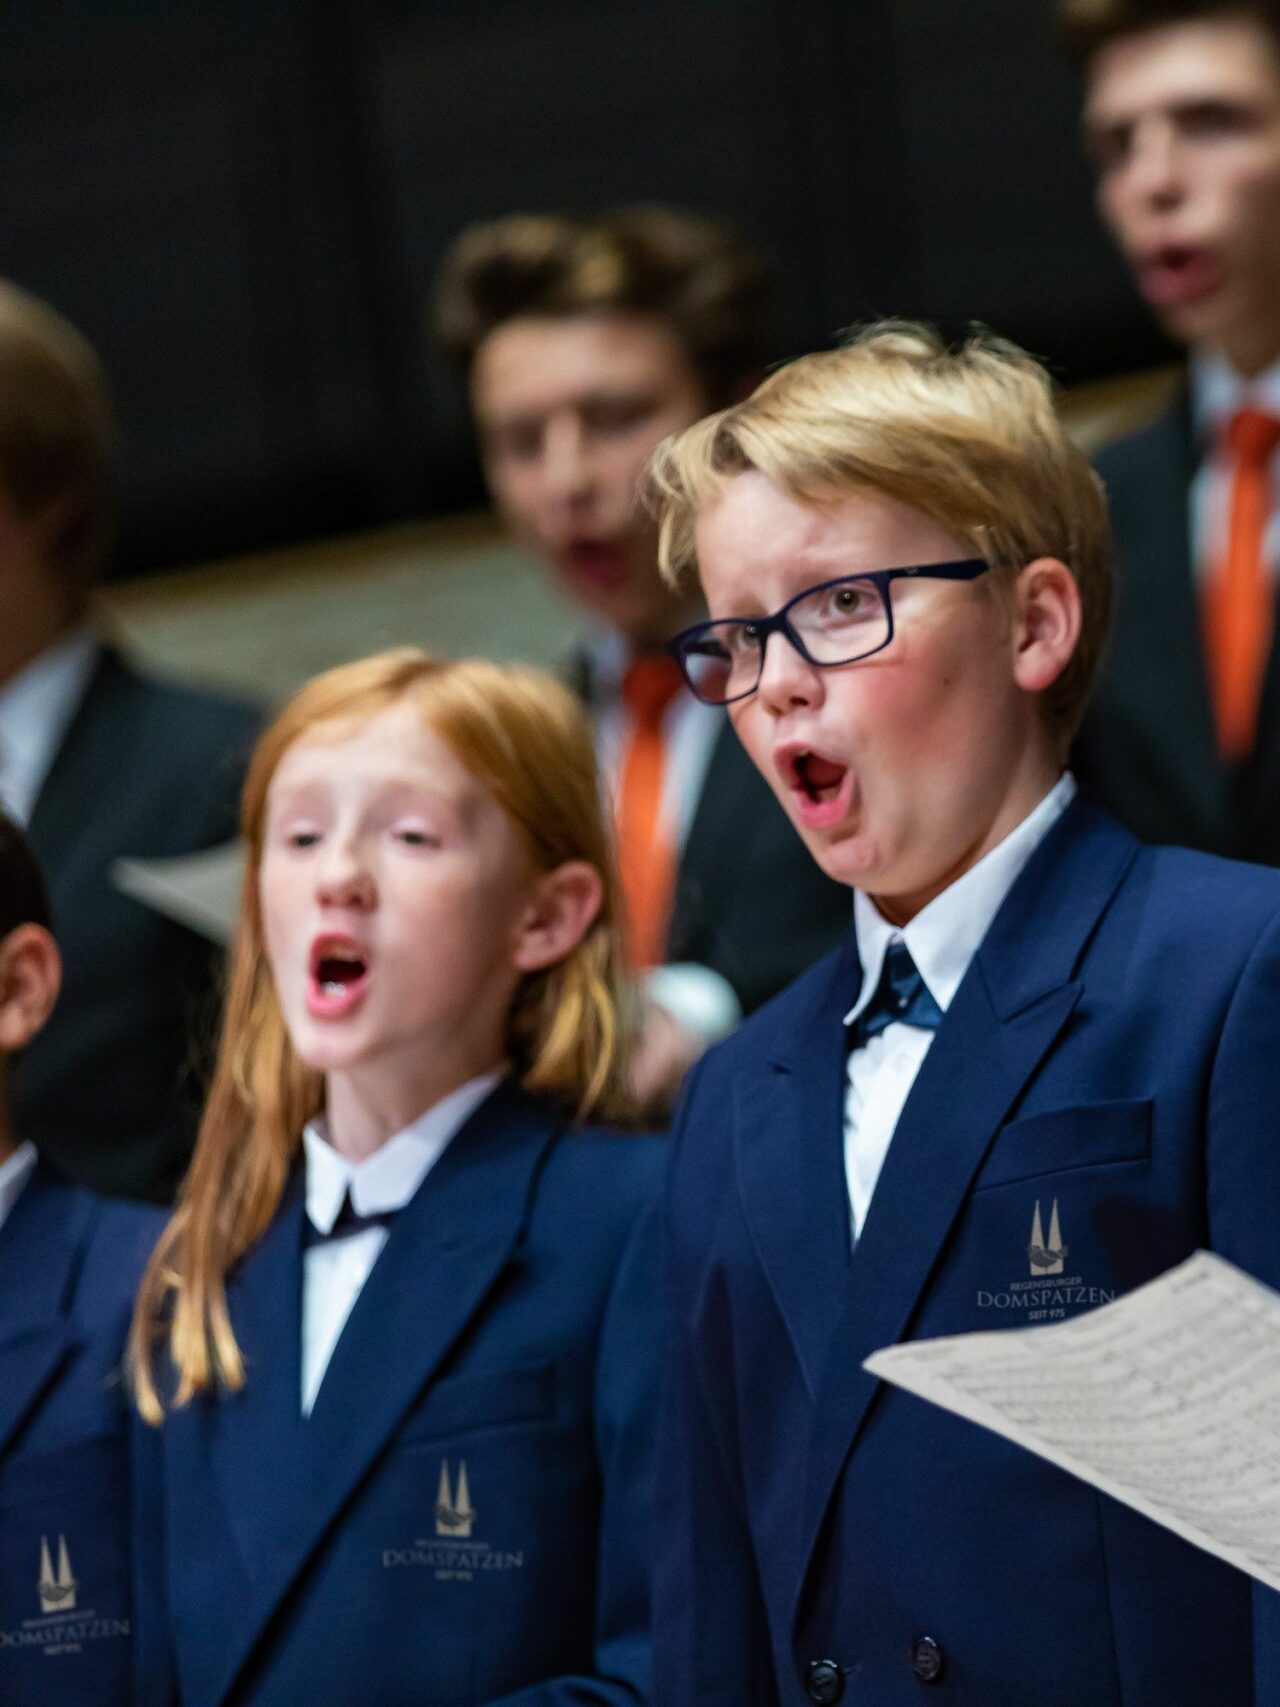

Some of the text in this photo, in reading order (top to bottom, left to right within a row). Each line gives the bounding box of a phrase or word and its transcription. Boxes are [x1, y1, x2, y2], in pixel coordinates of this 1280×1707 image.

[1010, 1276, 1083, 1291] REGENSBURGER
[976, 1287, 1117, 1309] DOMSPATZEN
[1028, 1308, 1066, 1320] SEIT 975
[382, 1549, 524, 1570] DOMSPATZEN
